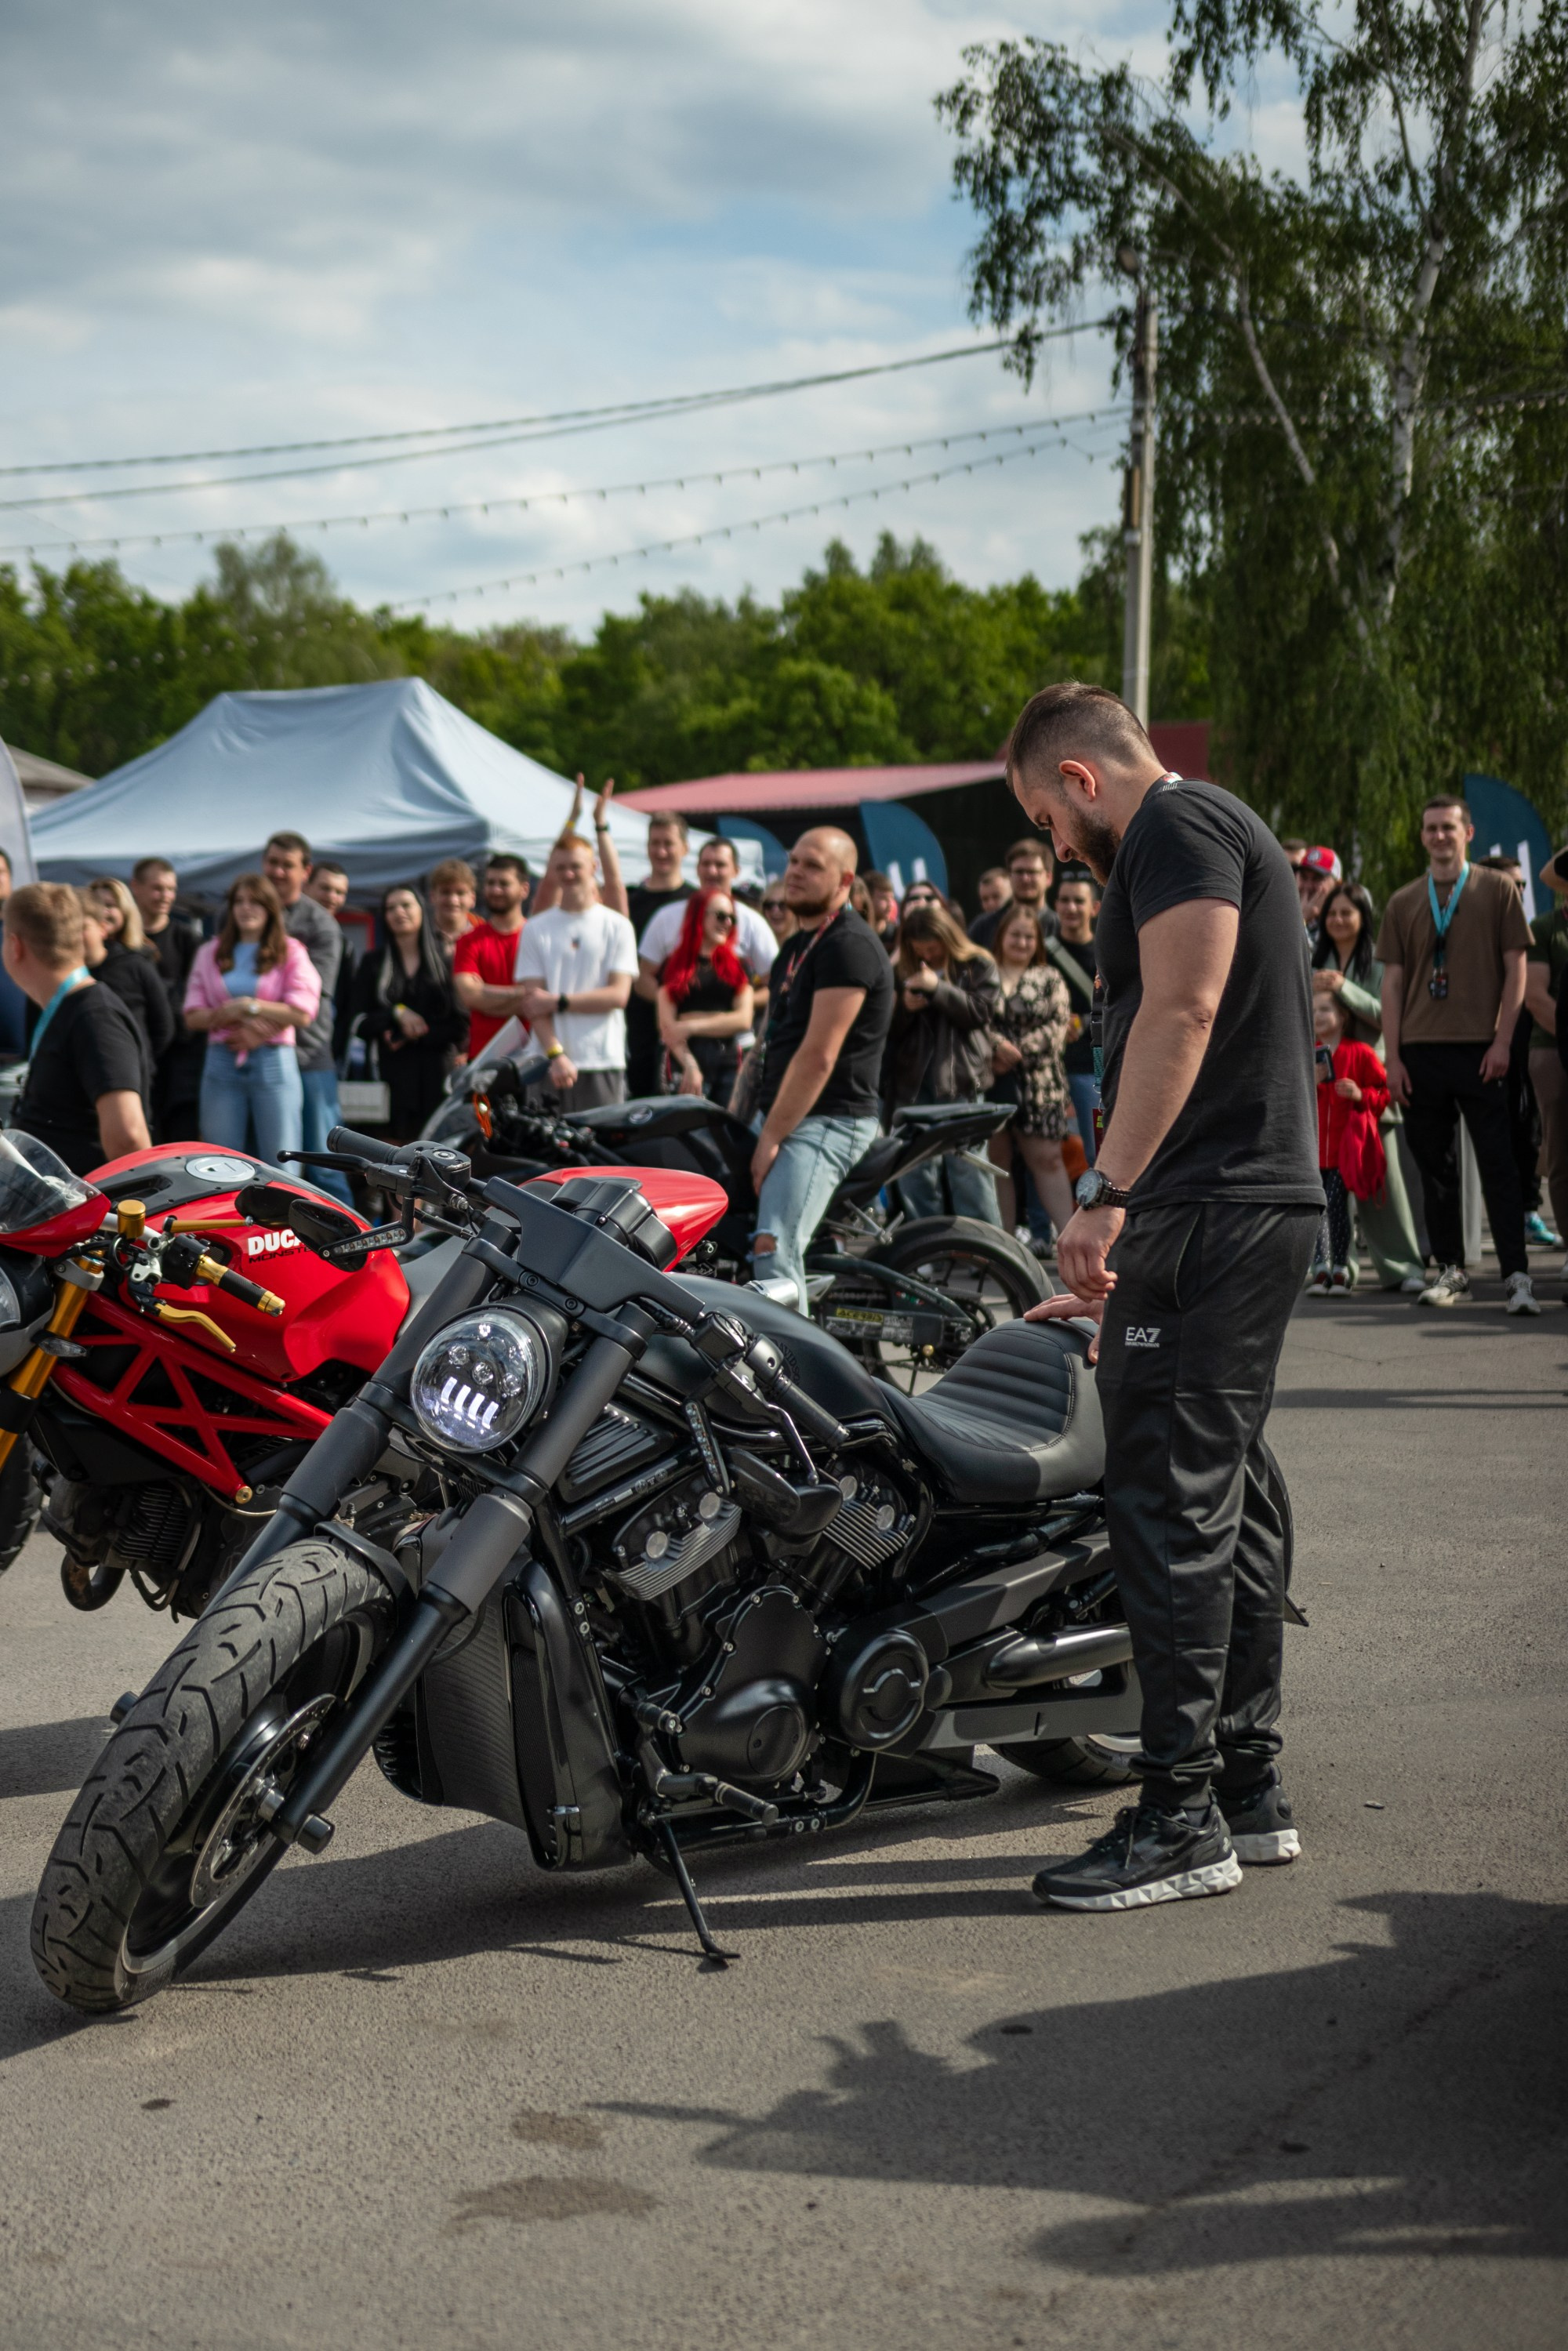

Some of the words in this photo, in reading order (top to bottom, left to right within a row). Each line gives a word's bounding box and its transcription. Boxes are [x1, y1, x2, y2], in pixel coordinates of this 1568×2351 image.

[248, 1229, 304, 1256] DUC
[249, 1246, 314, 1264] MONSTE
[1125, 1326, 1161, 1342] EA7
[771, 1339, 800, 1385] AVIDSO
